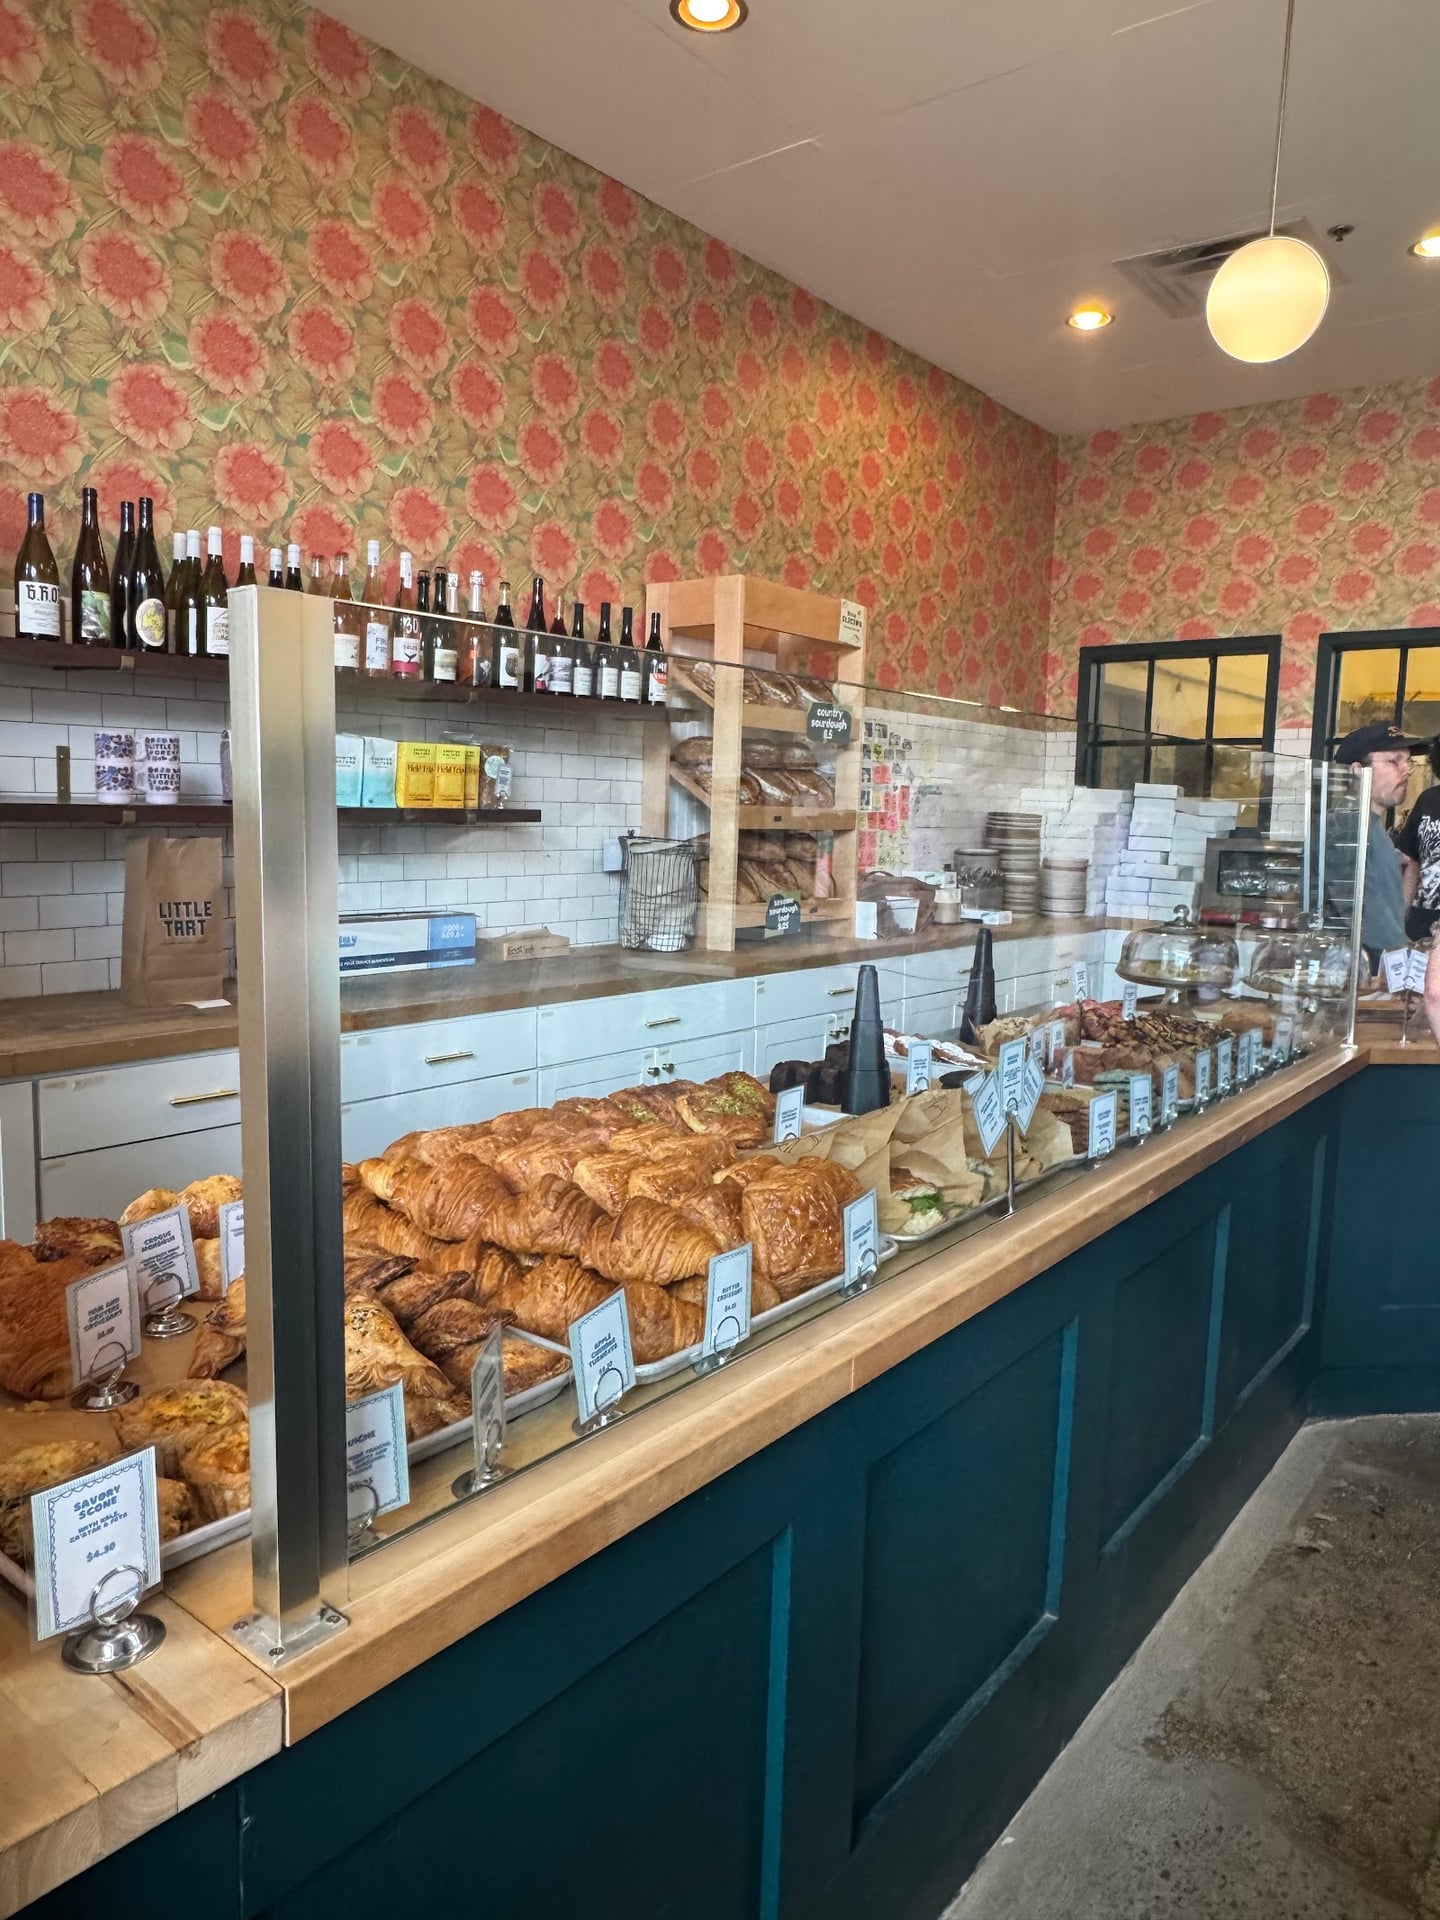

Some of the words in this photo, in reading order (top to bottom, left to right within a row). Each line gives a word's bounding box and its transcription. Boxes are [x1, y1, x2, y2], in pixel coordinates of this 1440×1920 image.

[816, 708, 844, 721] country
[811, 718, 848, 732] sourdough
[159, 901, 213, 919] LITTLE
[164, 919, 206, 938] TART
[594, 1333, 611, 1350] APPLE
[347, 1430, 376, 1447] UICHE
[73, 1484, 121, 1513] SAVORY
[79, 1495, 118, 1520] SCONE
[78, 1520, 99, 1534] WITH
[110, 1512, 128, 1525] FETA
